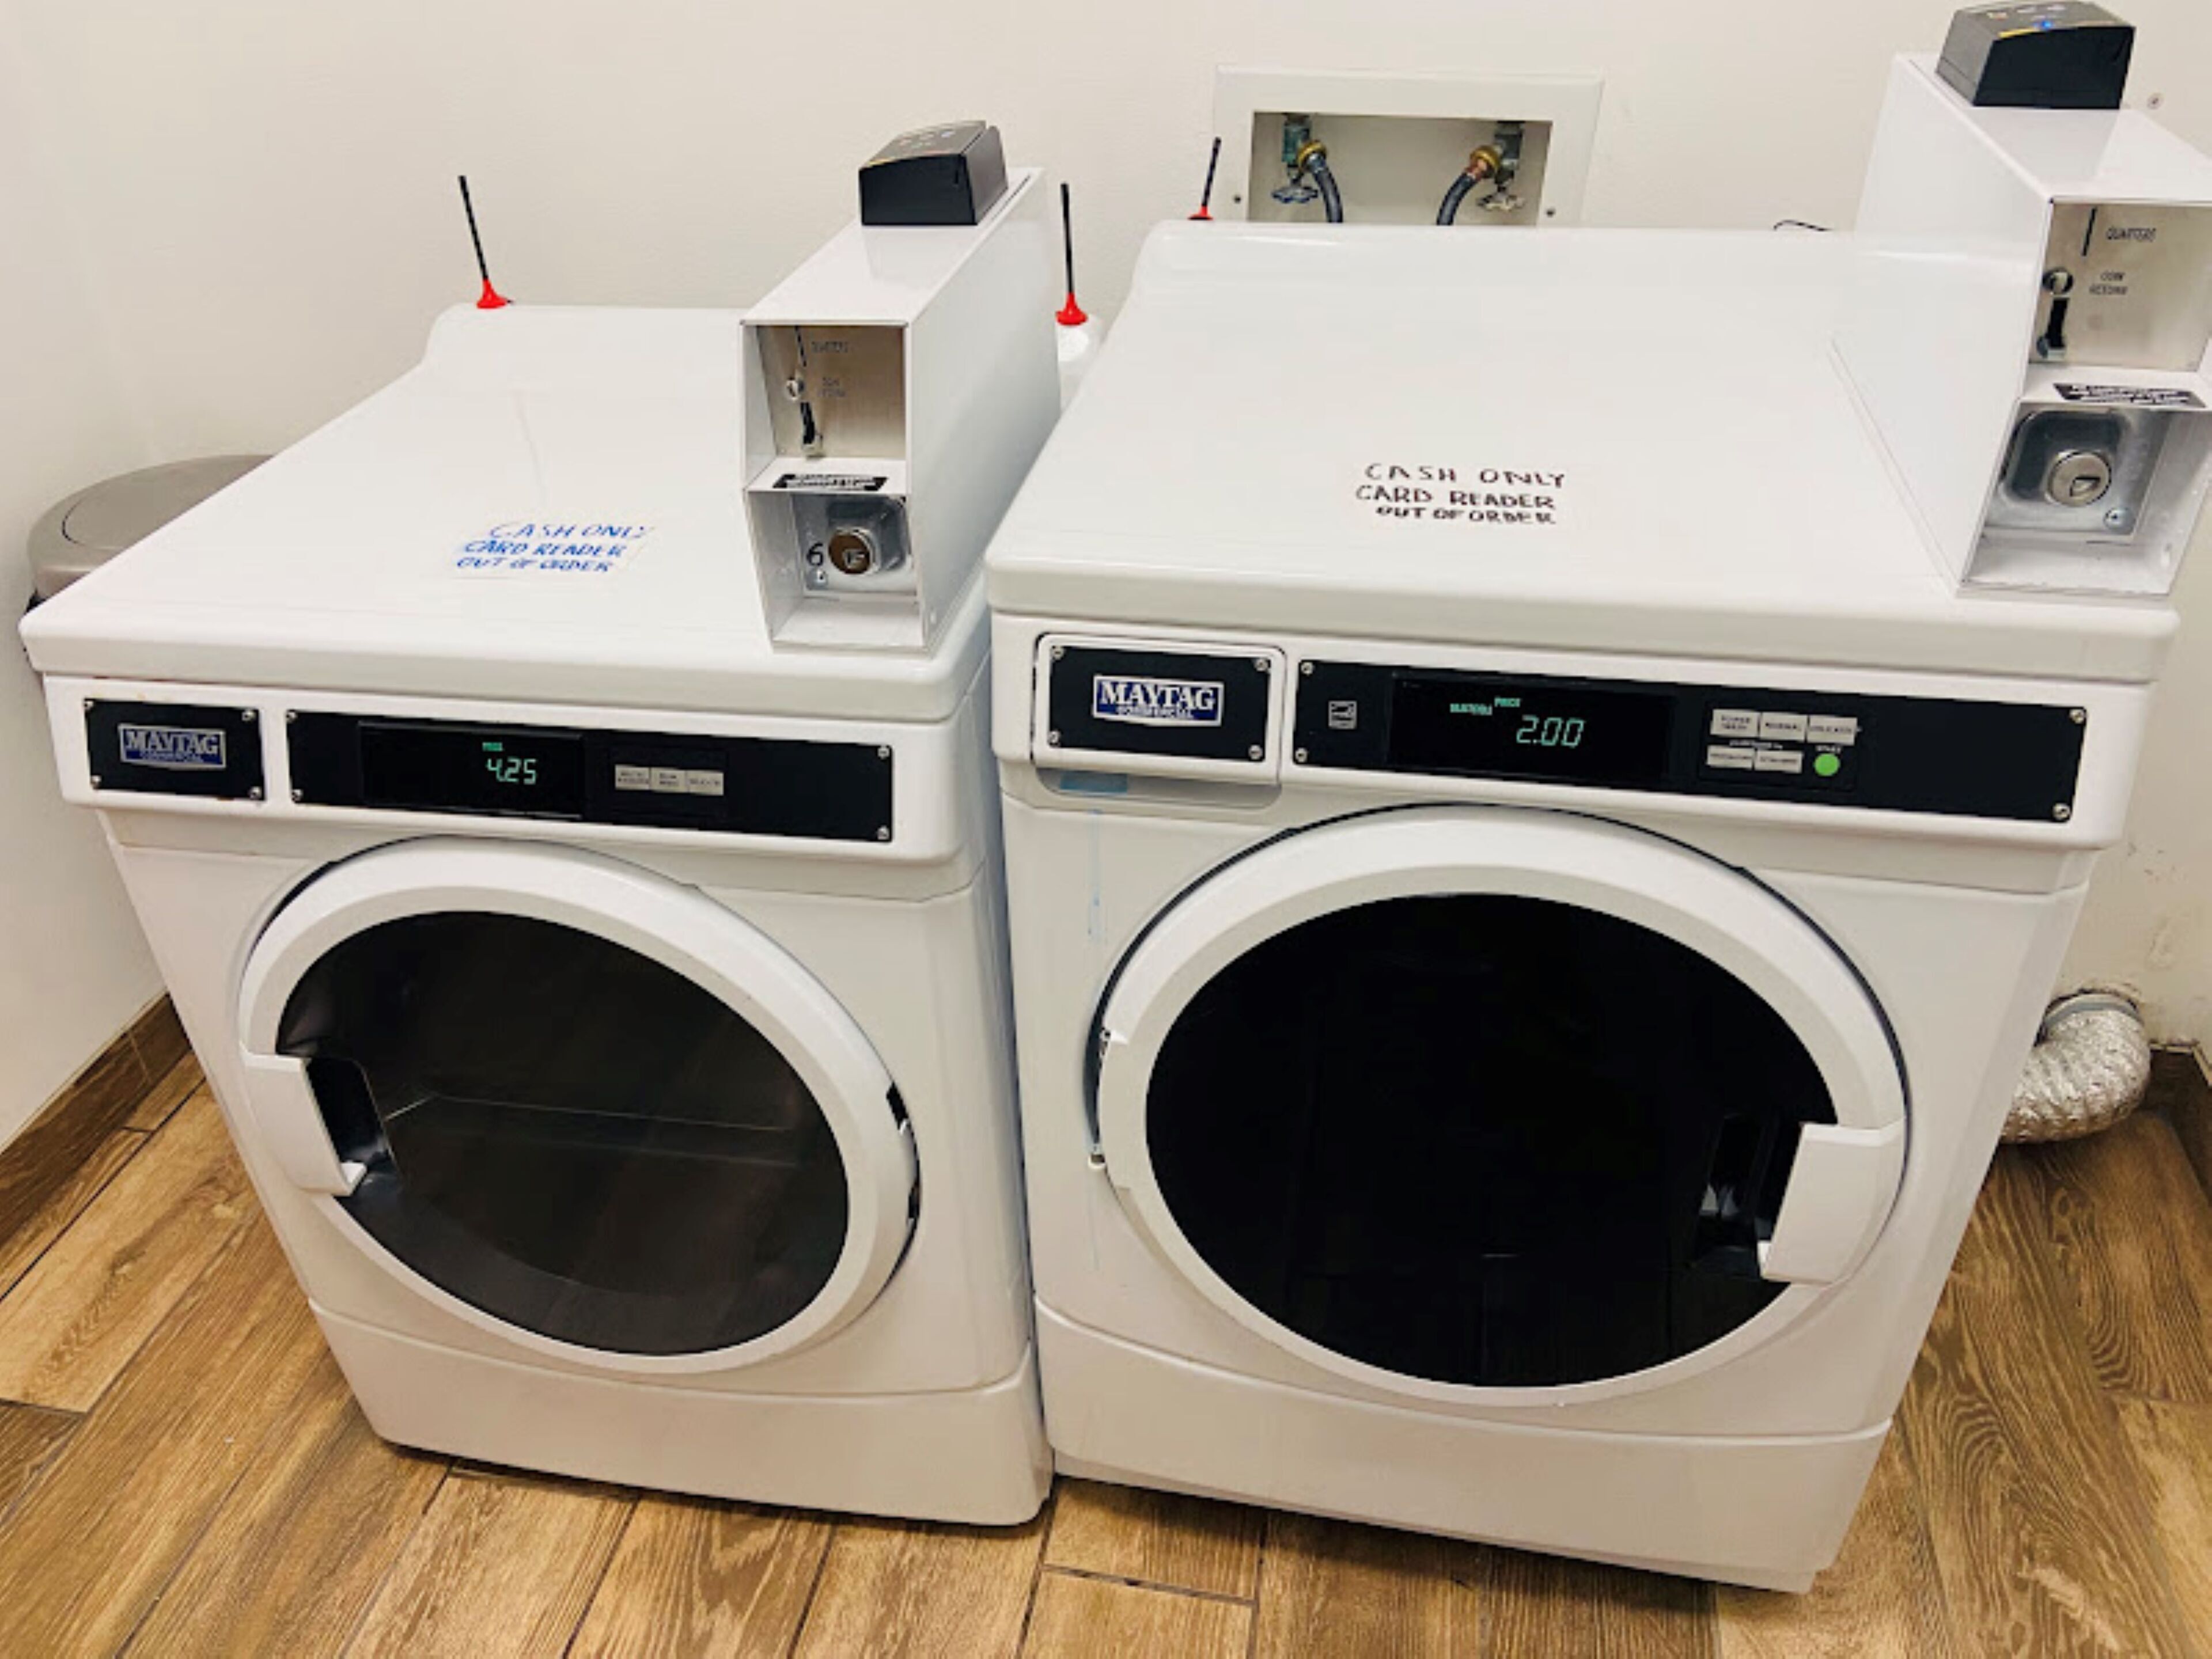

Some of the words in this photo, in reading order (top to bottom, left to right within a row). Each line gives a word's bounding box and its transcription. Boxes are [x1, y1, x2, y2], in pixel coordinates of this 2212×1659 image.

[1365, 463, 1456, 482] CASH
[1479, 468, 1565, 488] ONLY
[1355, 484, 1433, 503] CARD
[1449, 490, 1556, 509] READER
[1375, 506, 1426, 519] OUT
[1433, 507, 1463, 520] OF
[1468, 510, 1556, 524] ORDER
[490, 522, 577, 539] CASH
[463, 540, 529, 555] CARD
[533, 543, 627, 558] READER
[806, 543, 824, 566] 6
[456, 556, 509, 569] OUT
[539, 559, 614, 572] ORDER
[1099, 681, 1216, 710] MAYTAG
[125, 730, 219, 755] MAYTAG
[1516, 714, 1585, 747] 2.00
